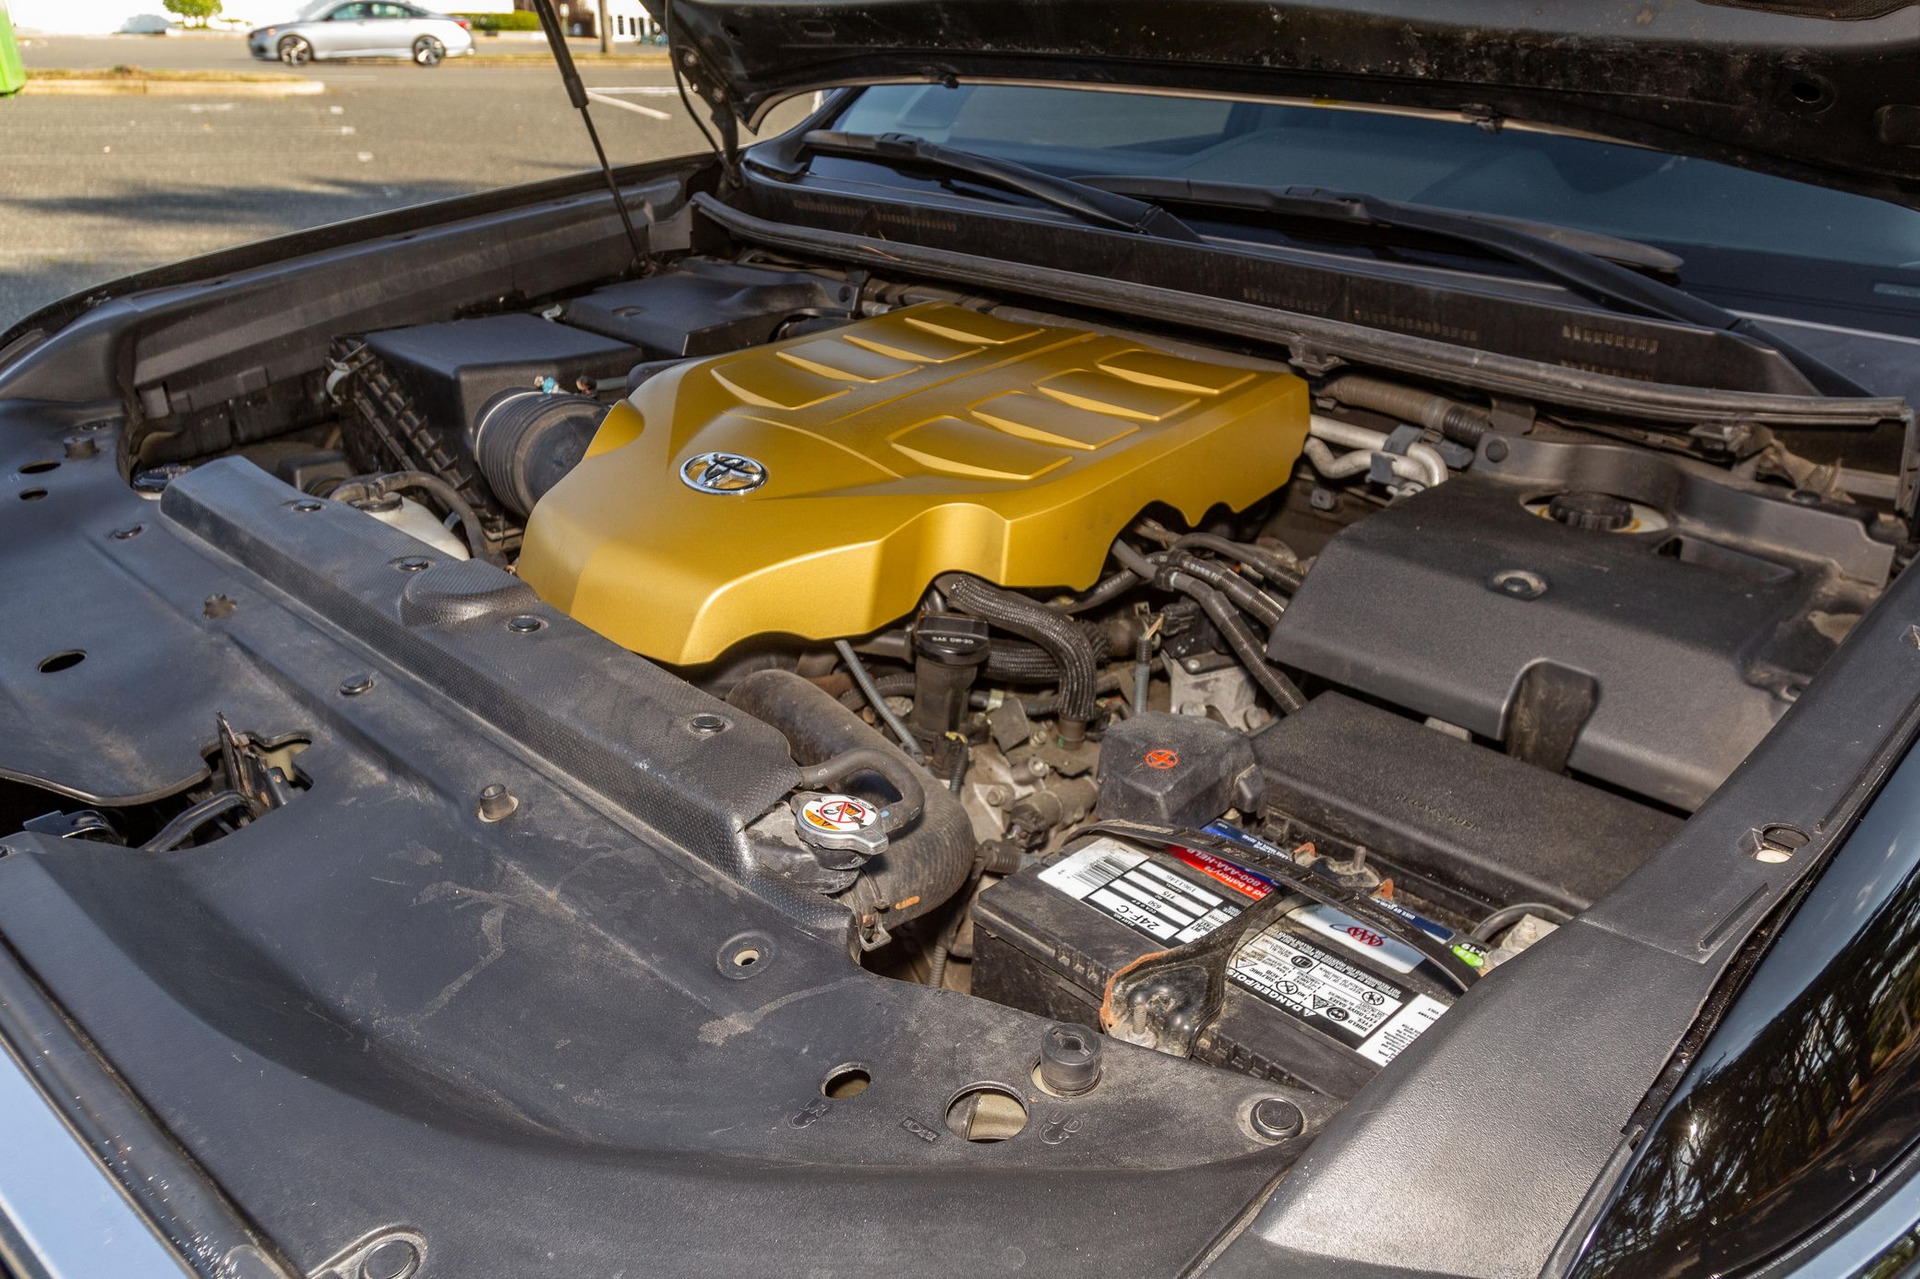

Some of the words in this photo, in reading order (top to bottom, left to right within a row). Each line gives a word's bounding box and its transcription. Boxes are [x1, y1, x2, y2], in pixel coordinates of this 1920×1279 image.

[1188, 848, 1260, 886] 800-AAA-HELP
[1167, 875, 1196, 892] 1961146
[1163, 891, 1175, 899] 115
[1148, 901, 1162, 909] 650
[1116, 905, 1159, 930] 24F-C
[1348, 927, 1383, 946] AAA
[1250, 968, 1274, 982] SULFURIC
[1265, 970, 1279, 978] ACID
[1319, 967, 1342, 980] CHILDREN
[1227, 969, 1302, 1011] DANGER/POIS
[1328, 991, 1354, 1006] BLINDNESS
[1329, 997, 1347, 1007] GASES
[1348, 1007, 1377, 1023] EXPLOSIVE
[1348, 1019, 1367, 1032] SHIELD
